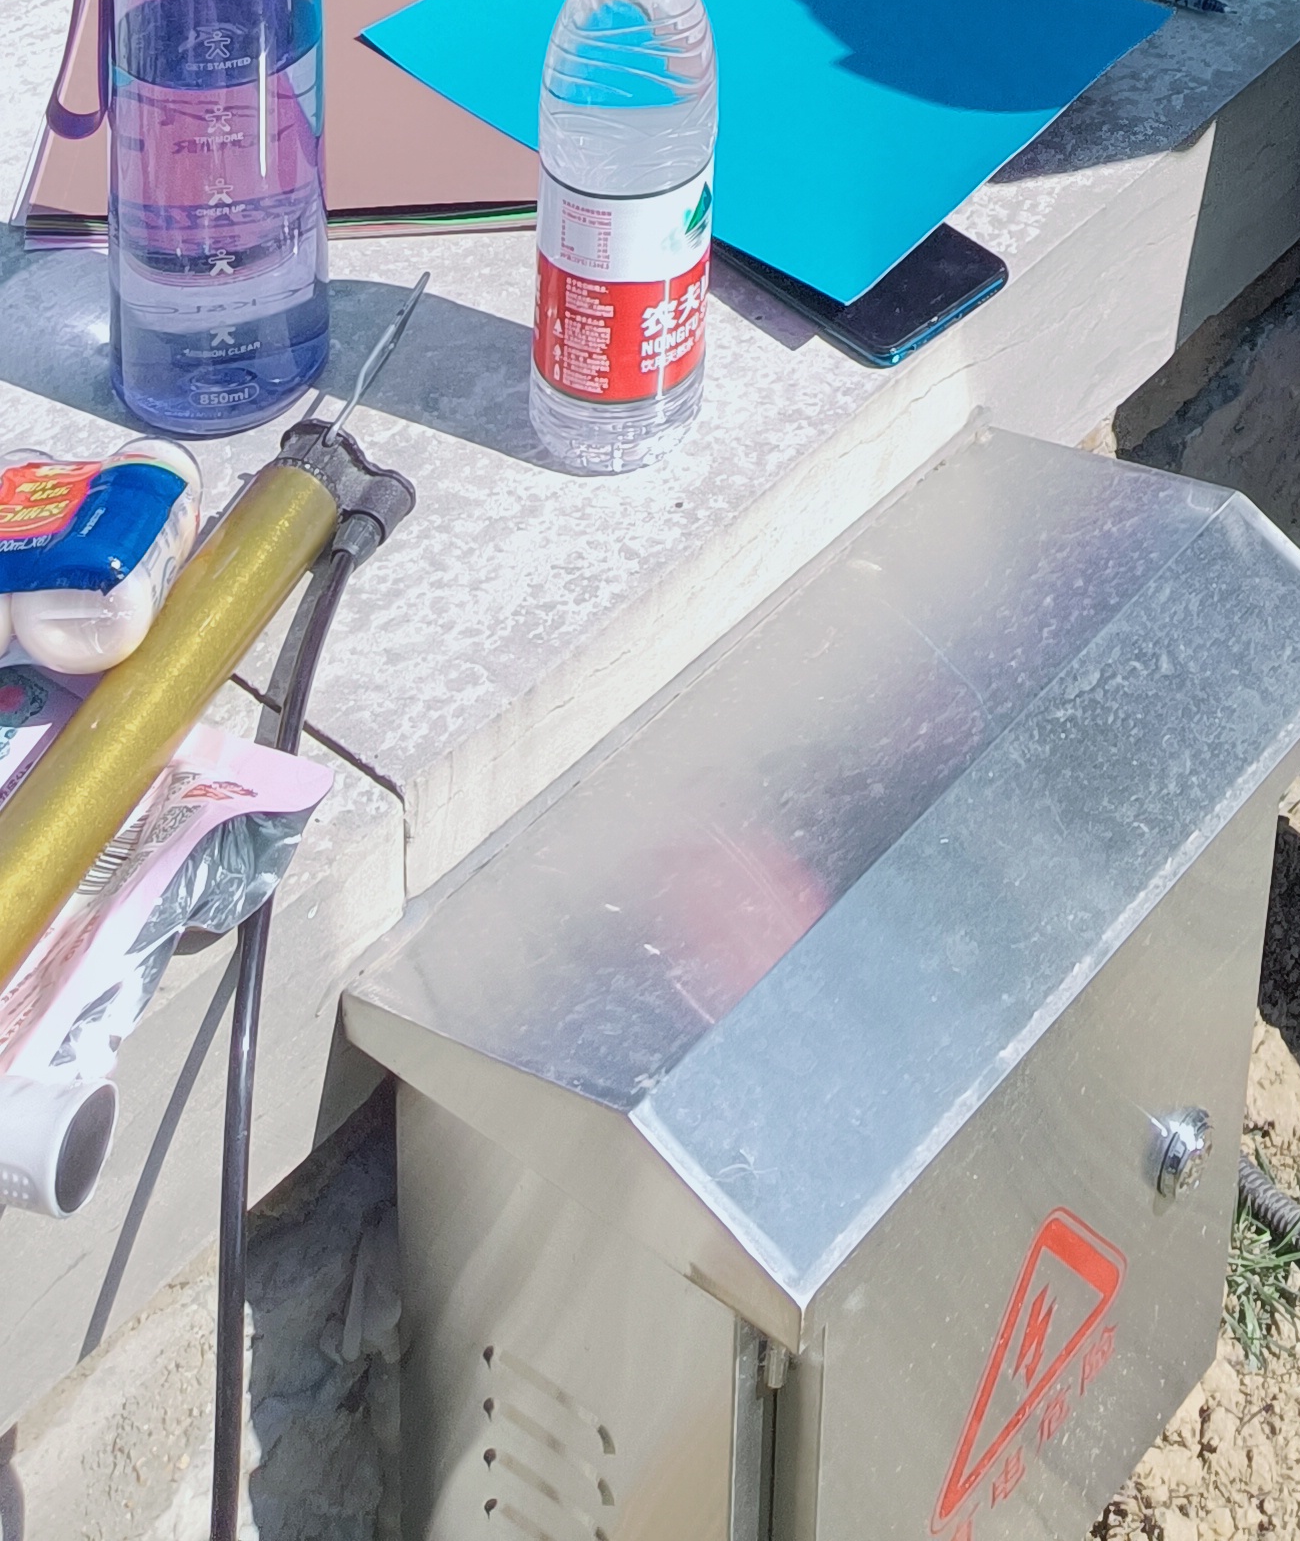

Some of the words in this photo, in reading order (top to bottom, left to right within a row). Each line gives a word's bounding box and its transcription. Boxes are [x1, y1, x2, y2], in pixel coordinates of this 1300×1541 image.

[207, 56, 252, 70] STARTED
[195, 205, 231, 217] CHEER
[231, 203, 247, 214] UP
[227, 341, 261, 356] CLEAR
[199, 387, 250, 405] 850ml
